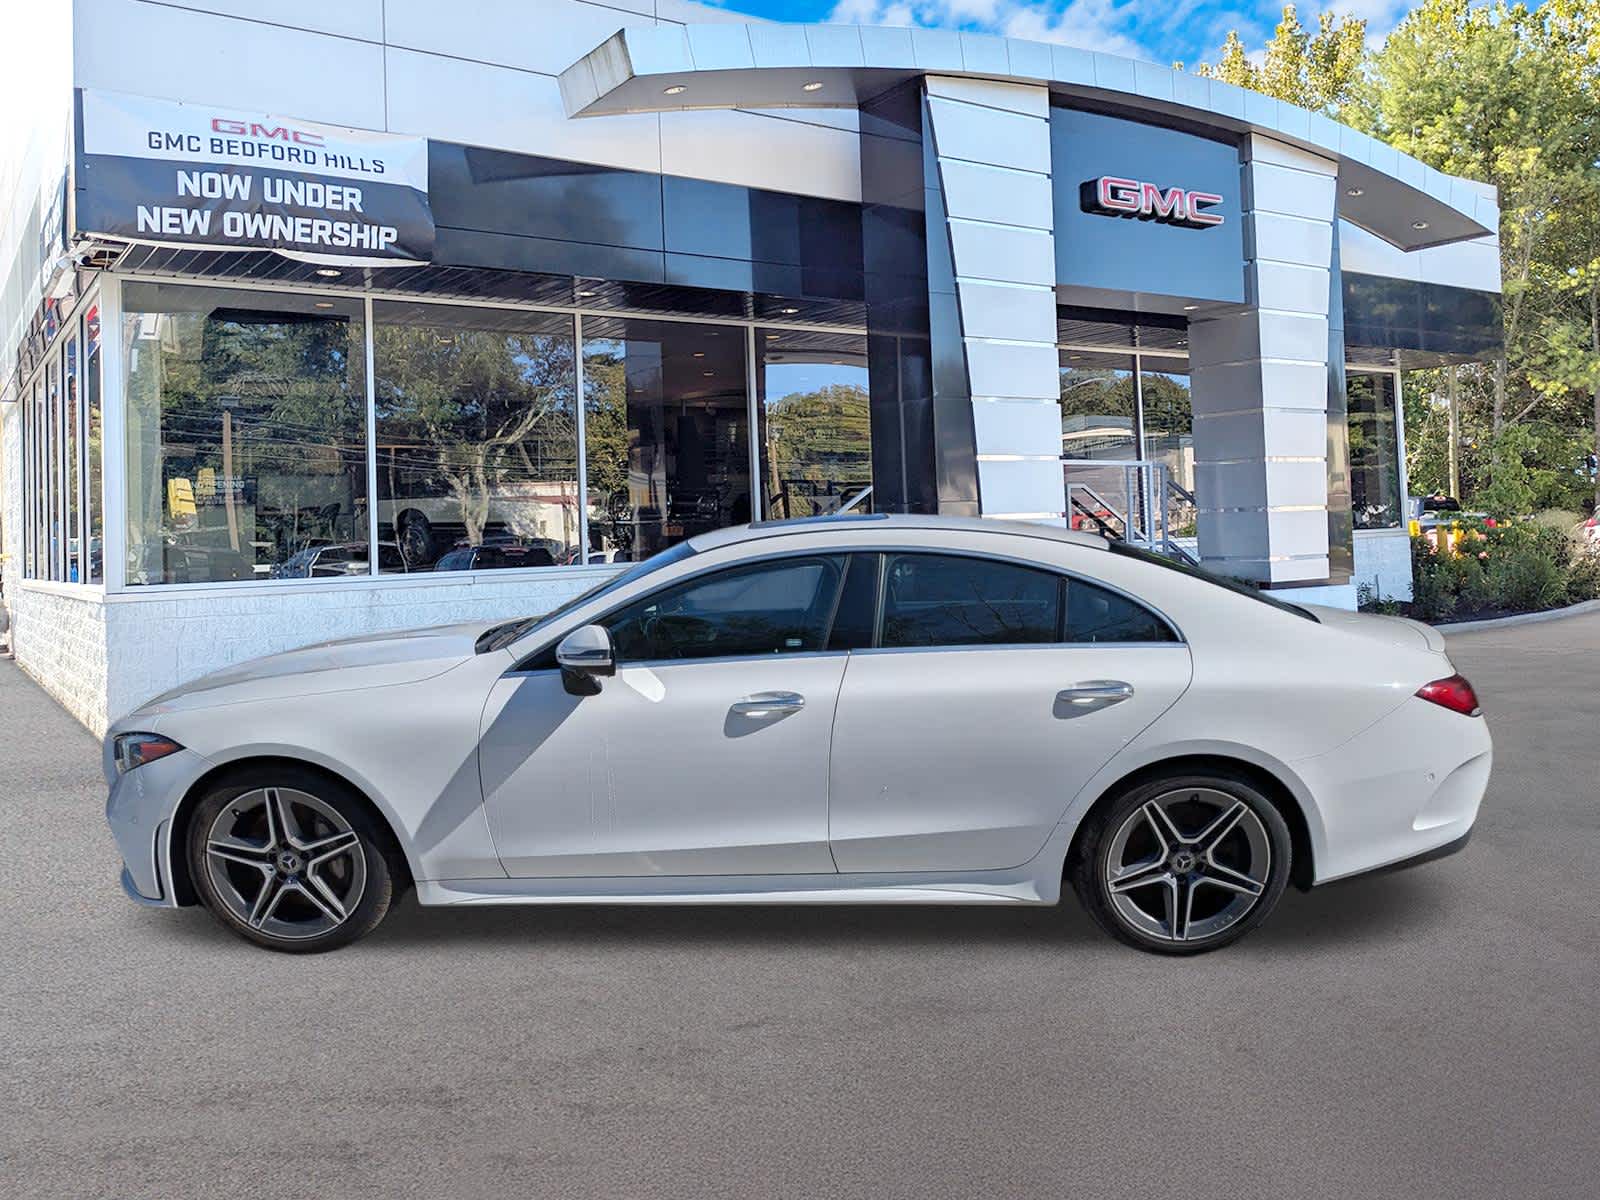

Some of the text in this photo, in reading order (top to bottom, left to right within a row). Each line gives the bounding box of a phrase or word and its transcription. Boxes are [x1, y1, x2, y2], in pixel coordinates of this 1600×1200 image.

[148, 131, 385, 174] GMC BEDFORD HILLS
[211, 118, 326, 148] GMC
[176, 170, 364, 213] NOW UNDER
[1096, 175, 1225, 226] GMC
[136, 205, 398, 251] NEW OWNERSHIP
